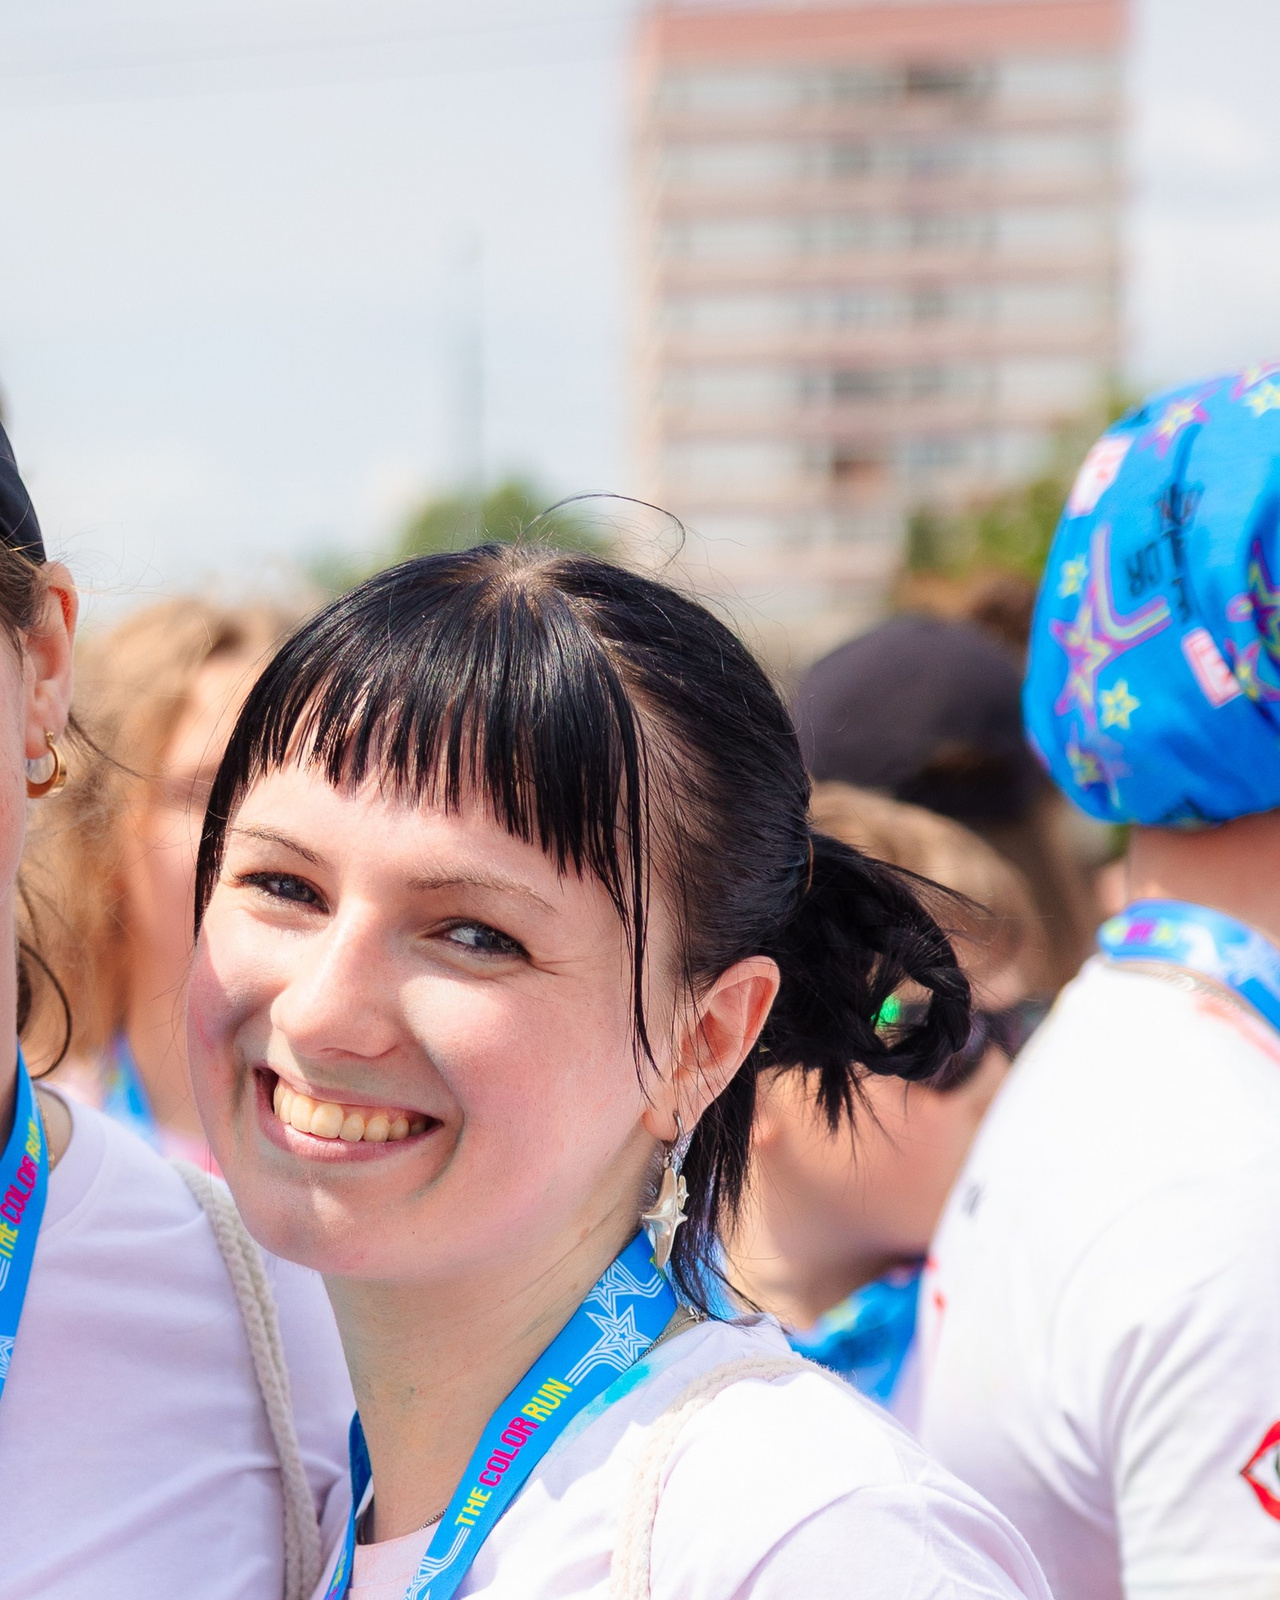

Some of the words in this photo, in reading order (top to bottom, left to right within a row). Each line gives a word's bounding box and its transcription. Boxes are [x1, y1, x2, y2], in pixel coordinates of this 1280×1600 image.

[0, 1155, 39, 1225] COLOR
[25, 1117, 42, 1164] RUN
[455, 1487, 492, 1529] THE
[479, 1417, 540, 1488] COLOR
[520, 1377, 574, 1422] RUN
